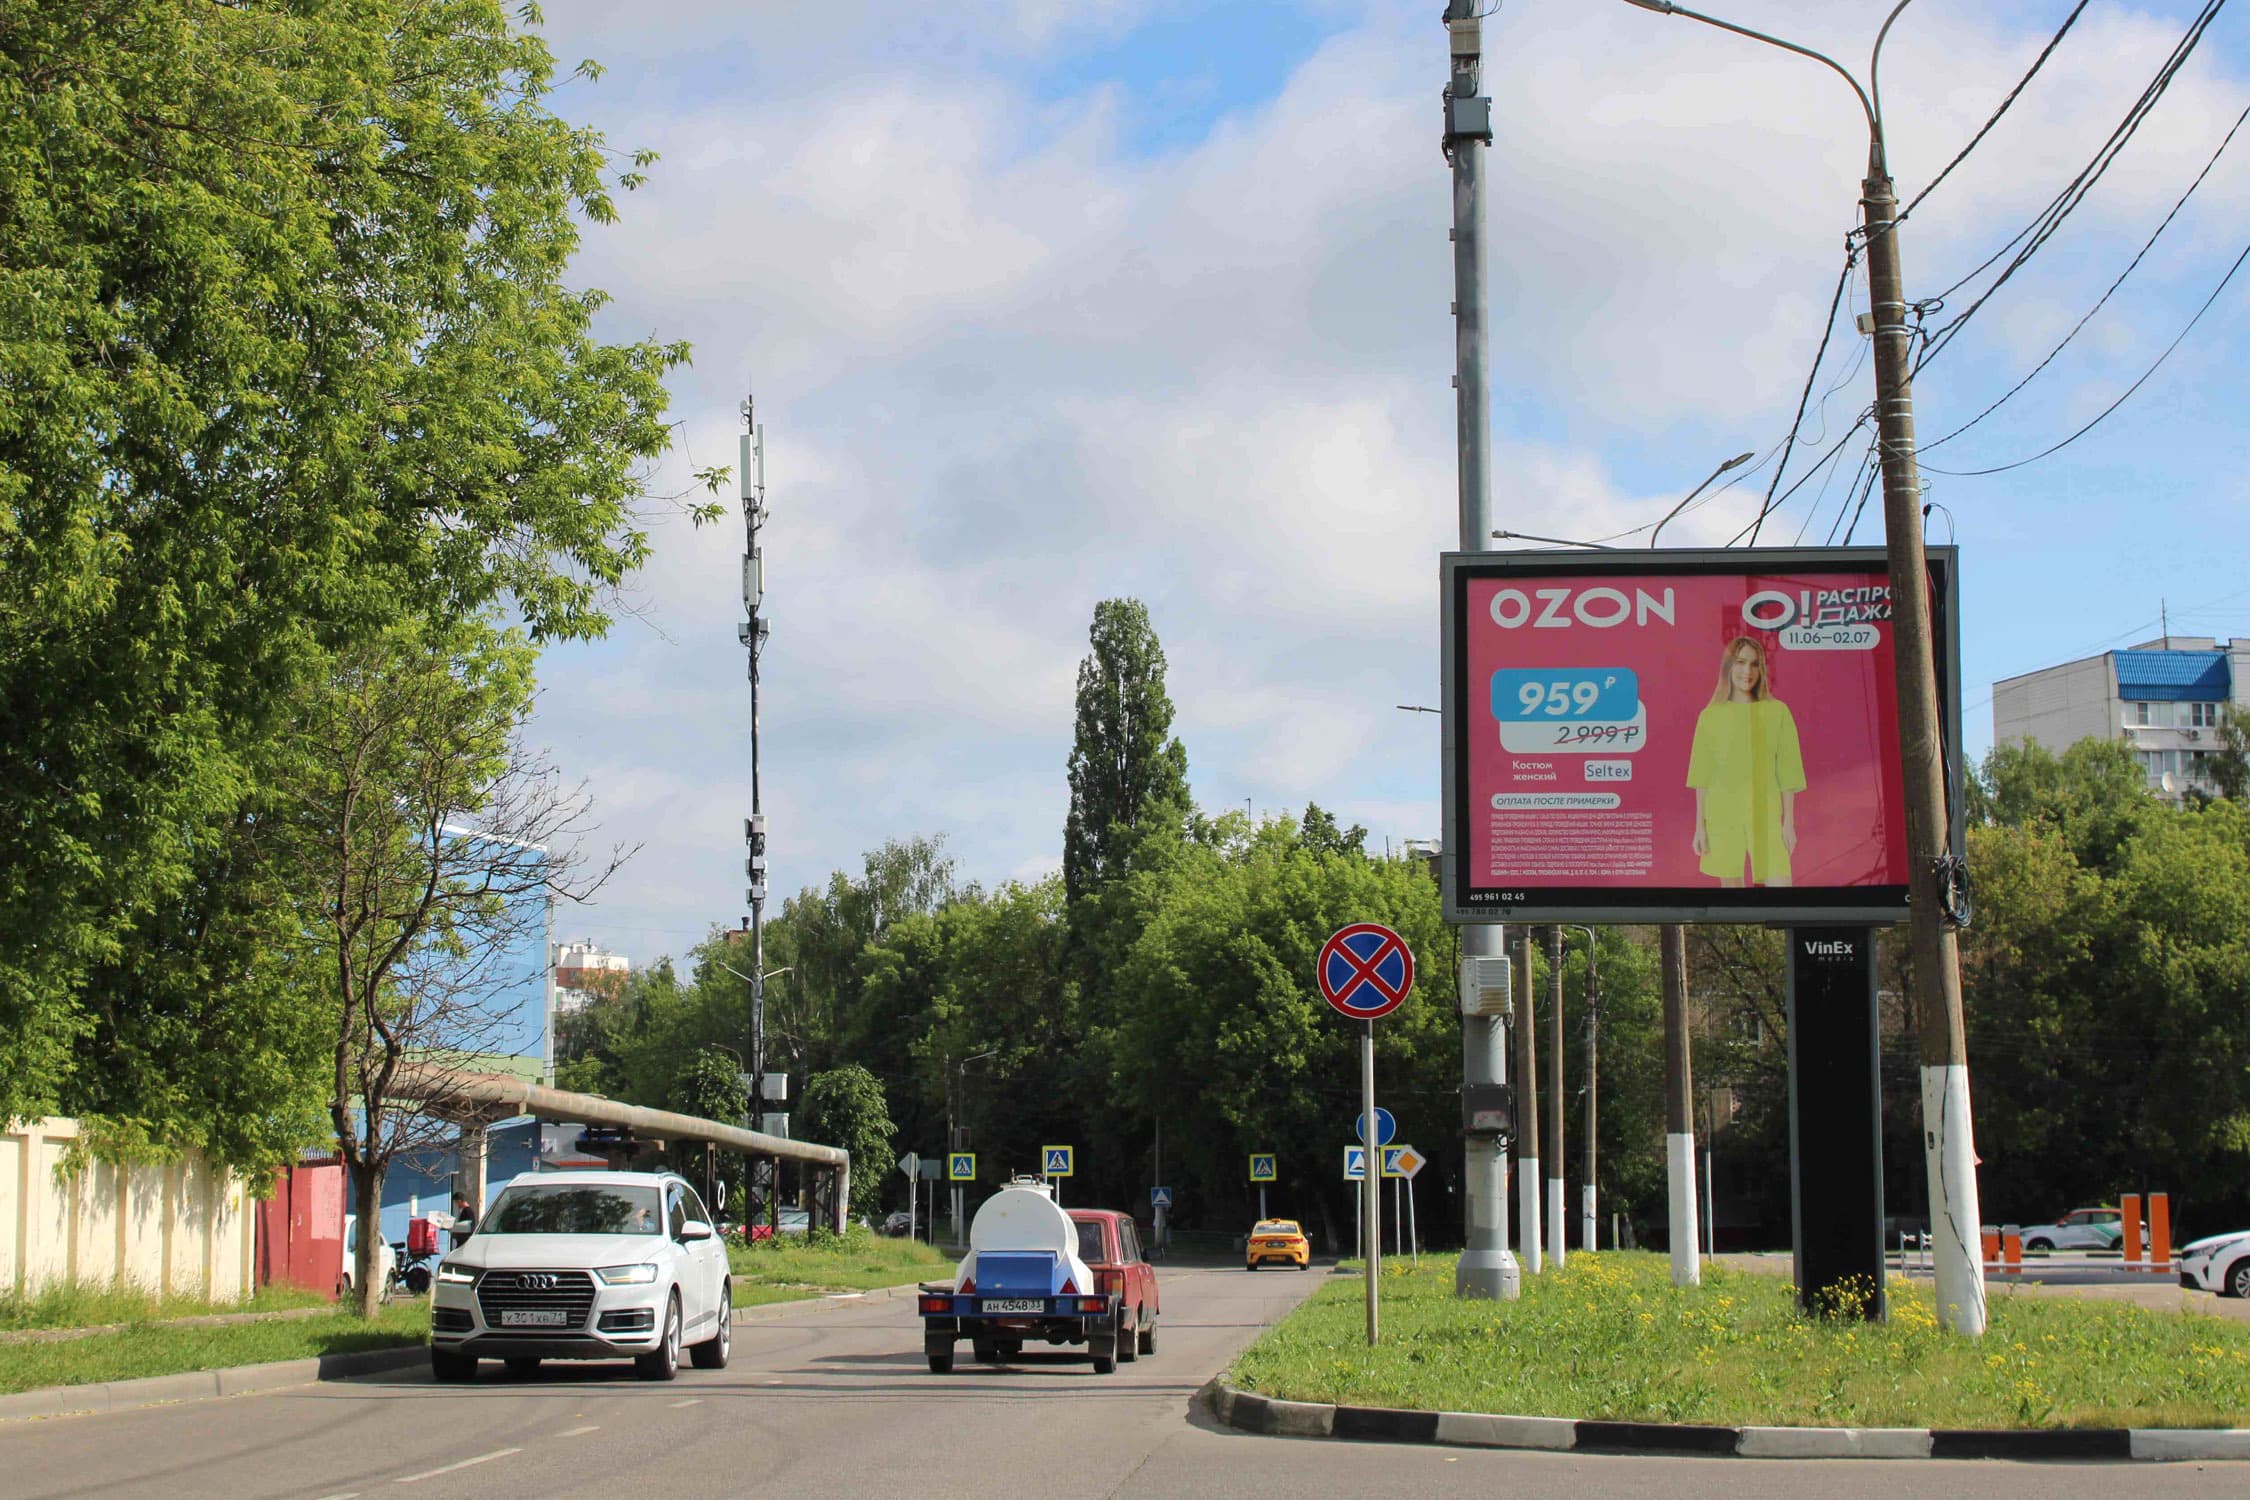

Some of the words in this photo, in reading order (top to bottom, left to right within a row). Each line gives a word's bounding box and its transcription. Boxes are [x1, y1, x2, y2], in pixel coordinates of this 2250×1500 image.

[1490, 587, 1675, 629] OZON
[1518, 681, 1599, 716] 959
[1558, 726, 1570, 744] 2
[1577, 726, 1618, 744] 999
[1512, 760, 1553, 769] Костюм
[1586, 764, 1630, 777] Seltex
[1513, 772, 1557, 781] женский
[1496, 797, 1532, 805] ОПЛАТА
[1533, 797, 1565, 805] ПОСЛЕ
[1566, 797, 1614, 805] ПРИМЕРКИ
[1502, 893, 1513, 901] 02
[1514, 893, 1525, 901] 45
[1805, 941, 1853, 955] VinEx
[1001, 1300, 1028, 1311] 4548
